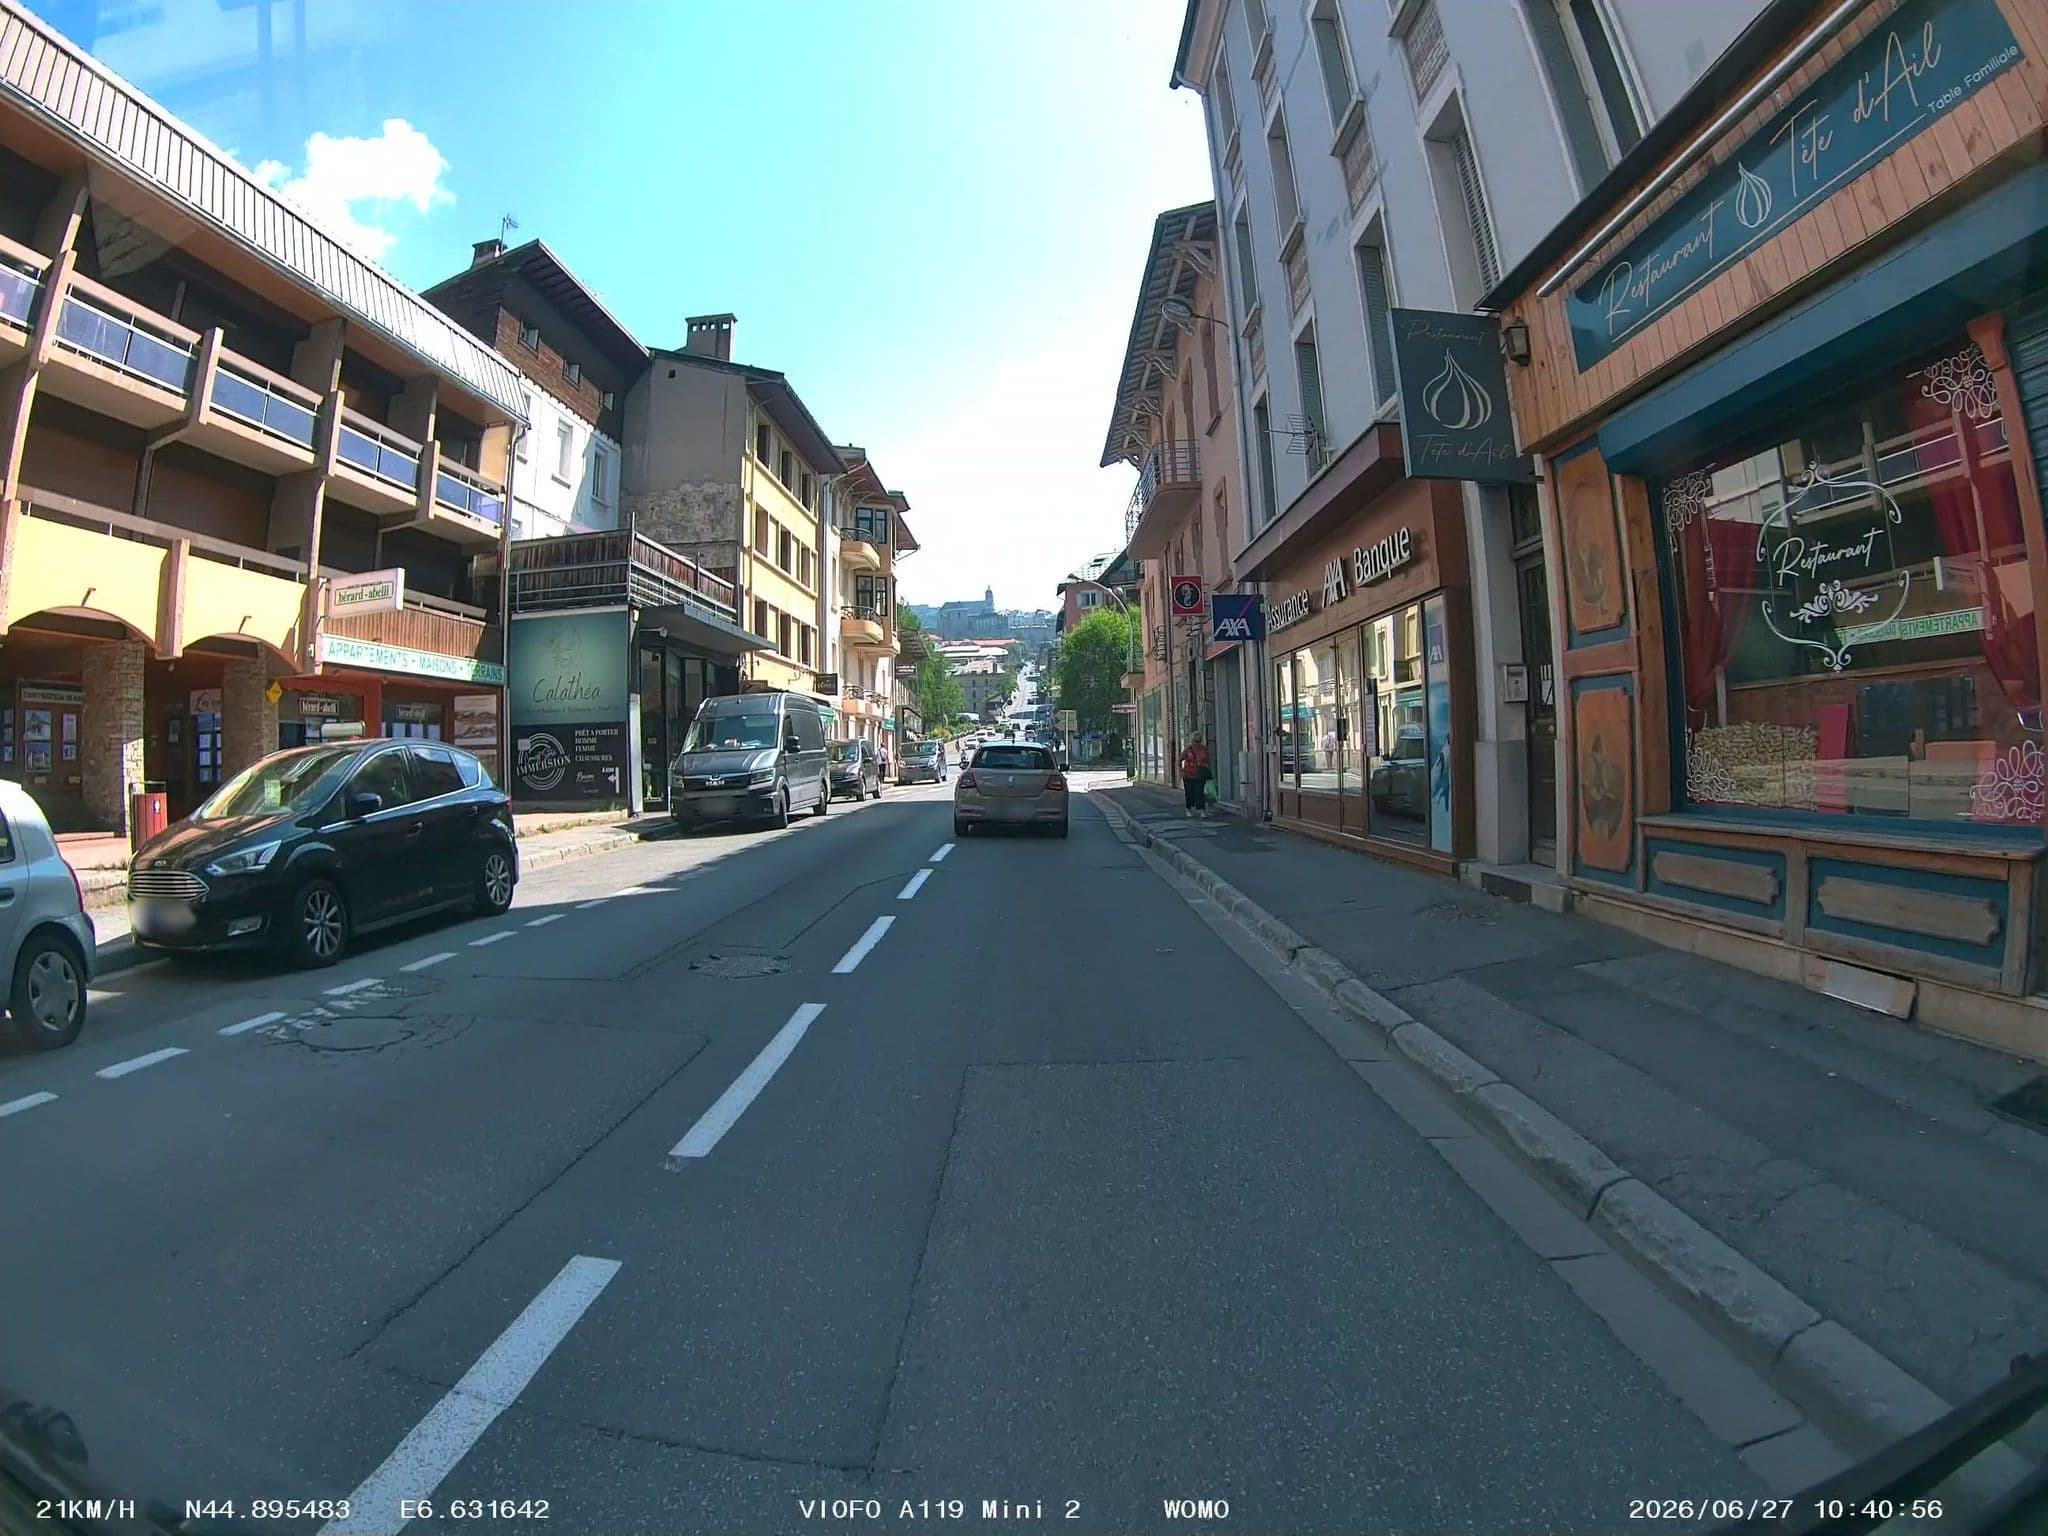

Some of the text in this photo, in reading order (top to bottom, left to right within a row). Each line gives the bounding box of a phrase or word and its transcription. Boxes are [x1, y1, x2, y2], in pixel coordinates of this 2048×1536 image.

[1927, 45, 2019, 114] Table Familiale
[1599, 21, 1941, 335] Restaurant Tête d'Ail
[1267, 526, 1410, 632] Assurance AXA Banque
[1773, 527, 1885, 586] Restaurant
[1214, 618, 1251, 637] AXA
[328, 640, 504, 682] APPARTEMENTS MAISONS TERRAINS
[533, 672, 601, 703] Calathéa
[516, 753, 571, 777] IMMERSION
